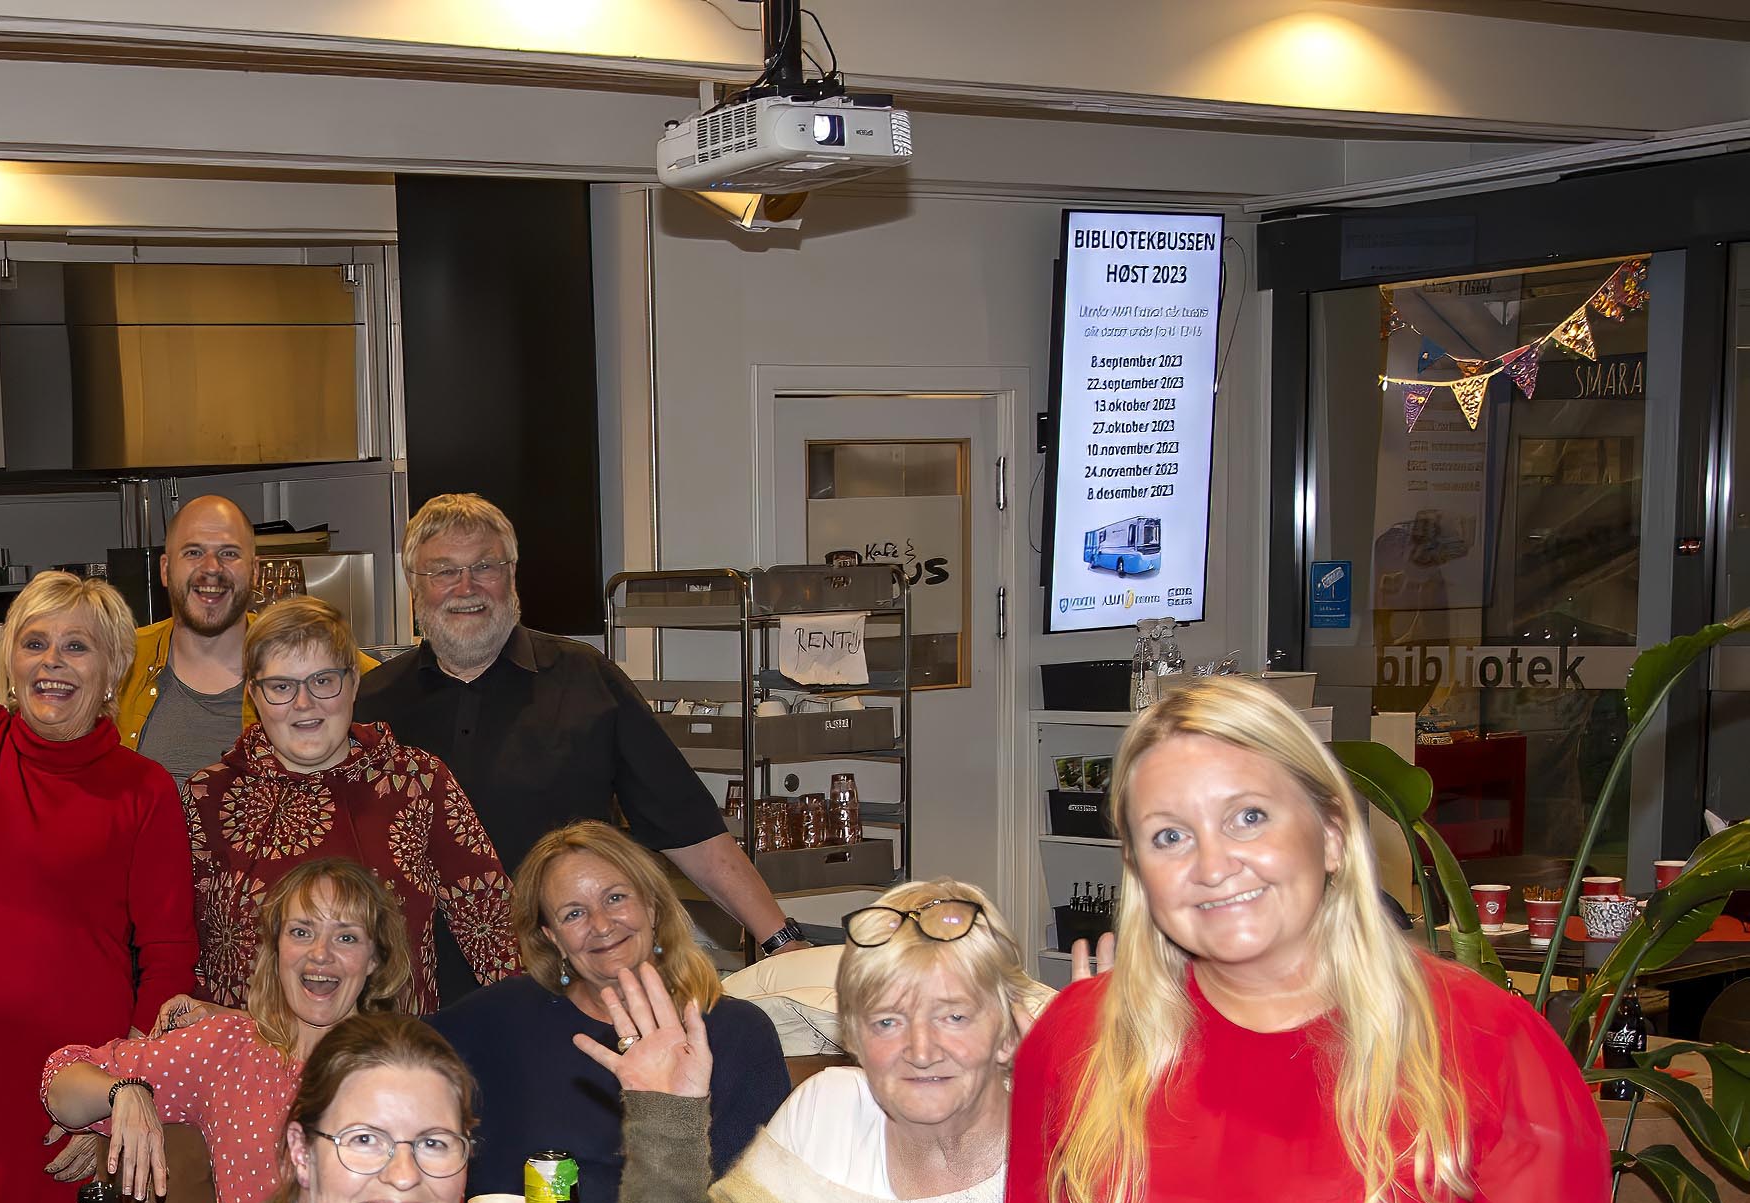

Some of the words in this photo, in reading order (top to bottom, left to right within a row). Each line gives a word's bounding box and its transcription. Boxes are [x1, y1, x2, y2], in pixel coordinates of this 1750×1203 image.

[1074, 229, 1216, 251] BIBLIOTEKBUSSEN
[1106, 263, 1149, 283] HØST
[1152, 265, 1187, 283] 2023
[1376, 645, 1586, 690] bibliotek
